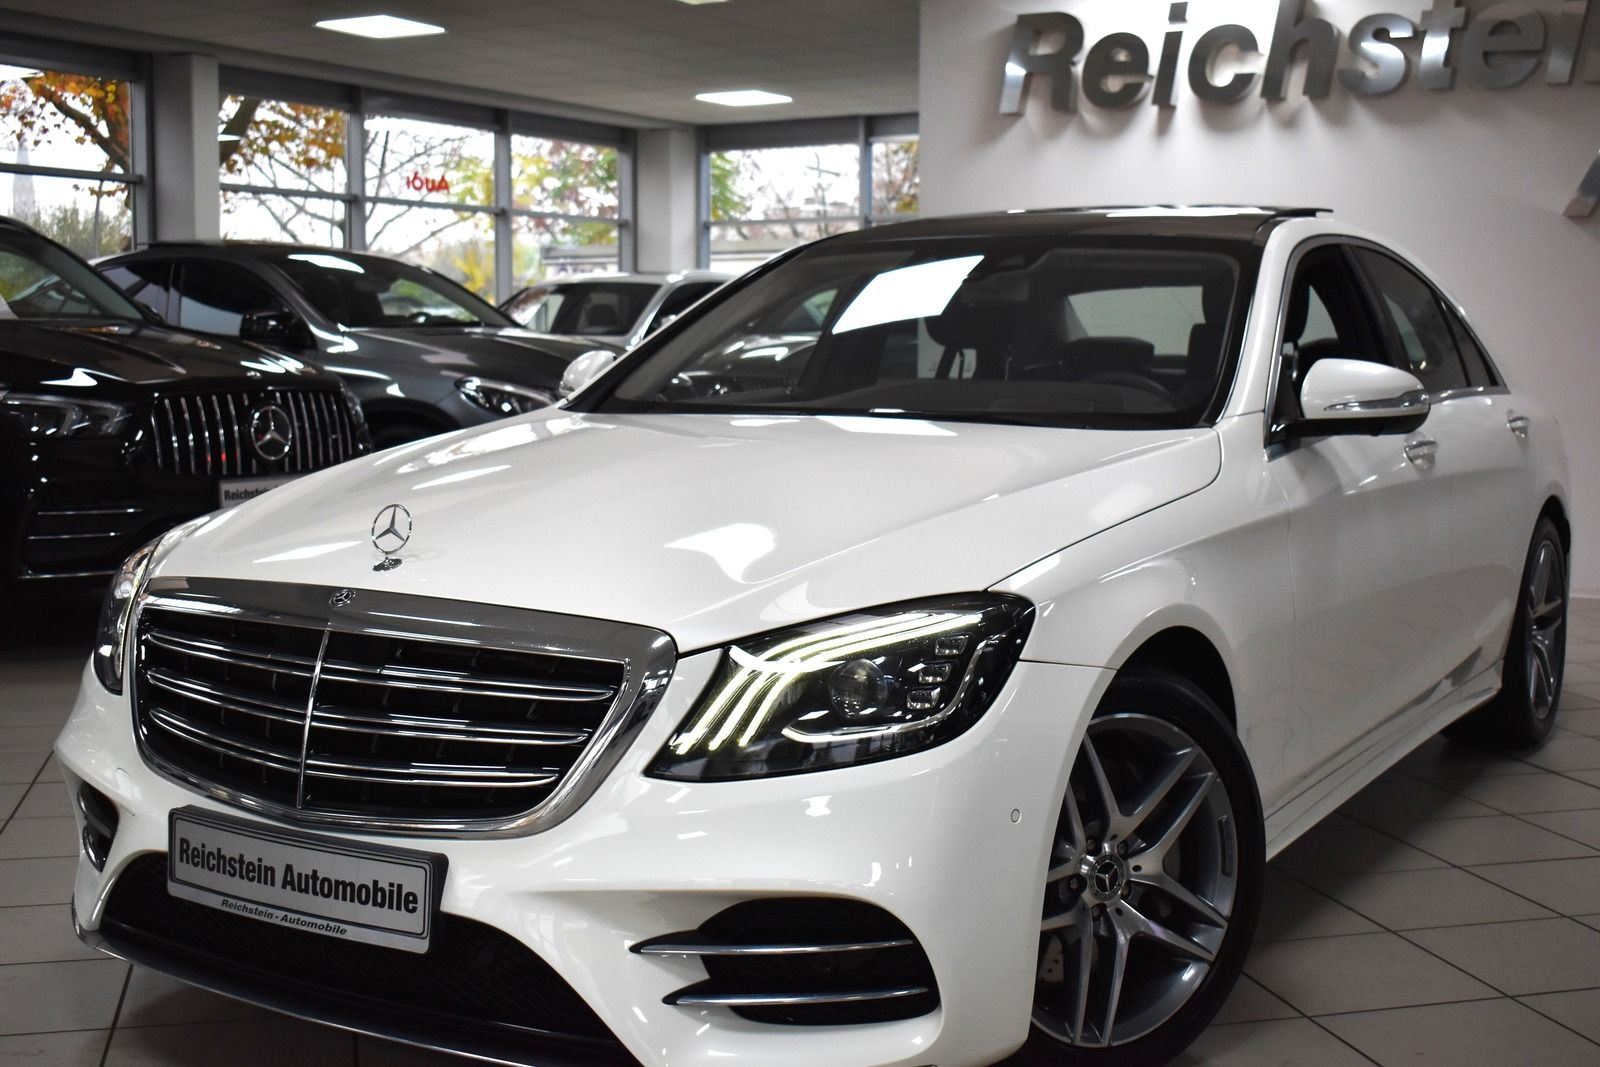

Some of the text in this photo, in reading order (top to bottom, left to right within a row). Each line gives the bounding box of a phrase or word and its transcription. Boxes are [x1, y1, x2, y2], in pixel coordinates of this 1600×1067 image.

[999, 0, 1600, 116] Reichstei
[179, 837, 419, 914] Reichstein Automobile
[221, 899, 274, 920] Reichstein
[280, 914, 347, 936] Automobile
